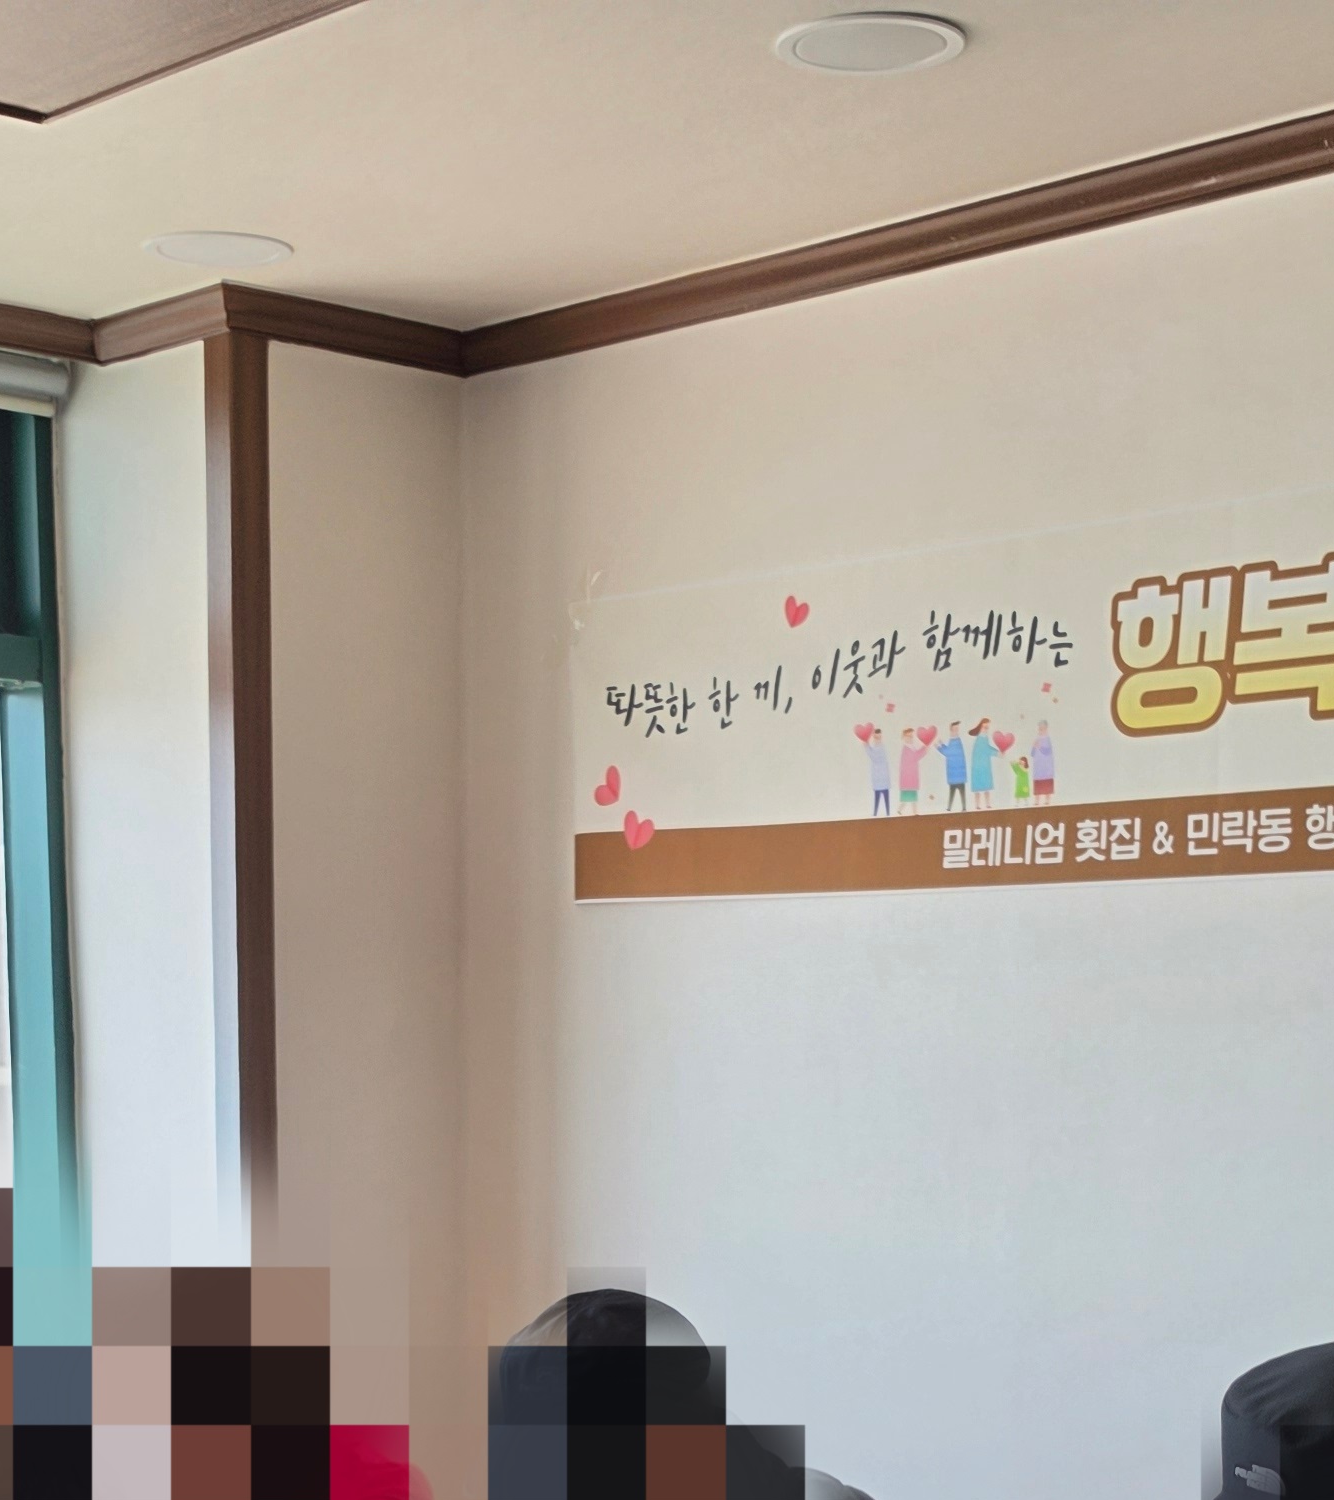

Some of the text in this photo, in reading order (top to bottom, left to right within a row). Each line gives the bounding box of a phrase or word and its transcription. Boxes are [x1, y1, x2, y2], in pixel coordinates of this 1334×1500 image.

[605, 610, 1073, 739] 따뜻한 한 끼, 이웃과 함께하는
[942, 822, 1065, 869] 밀레니엄
[1075, 817, 1141, 863] 횟집
[1152, 820, 1174, 855] &
[1186, 807, 1292, 856] 민락동
